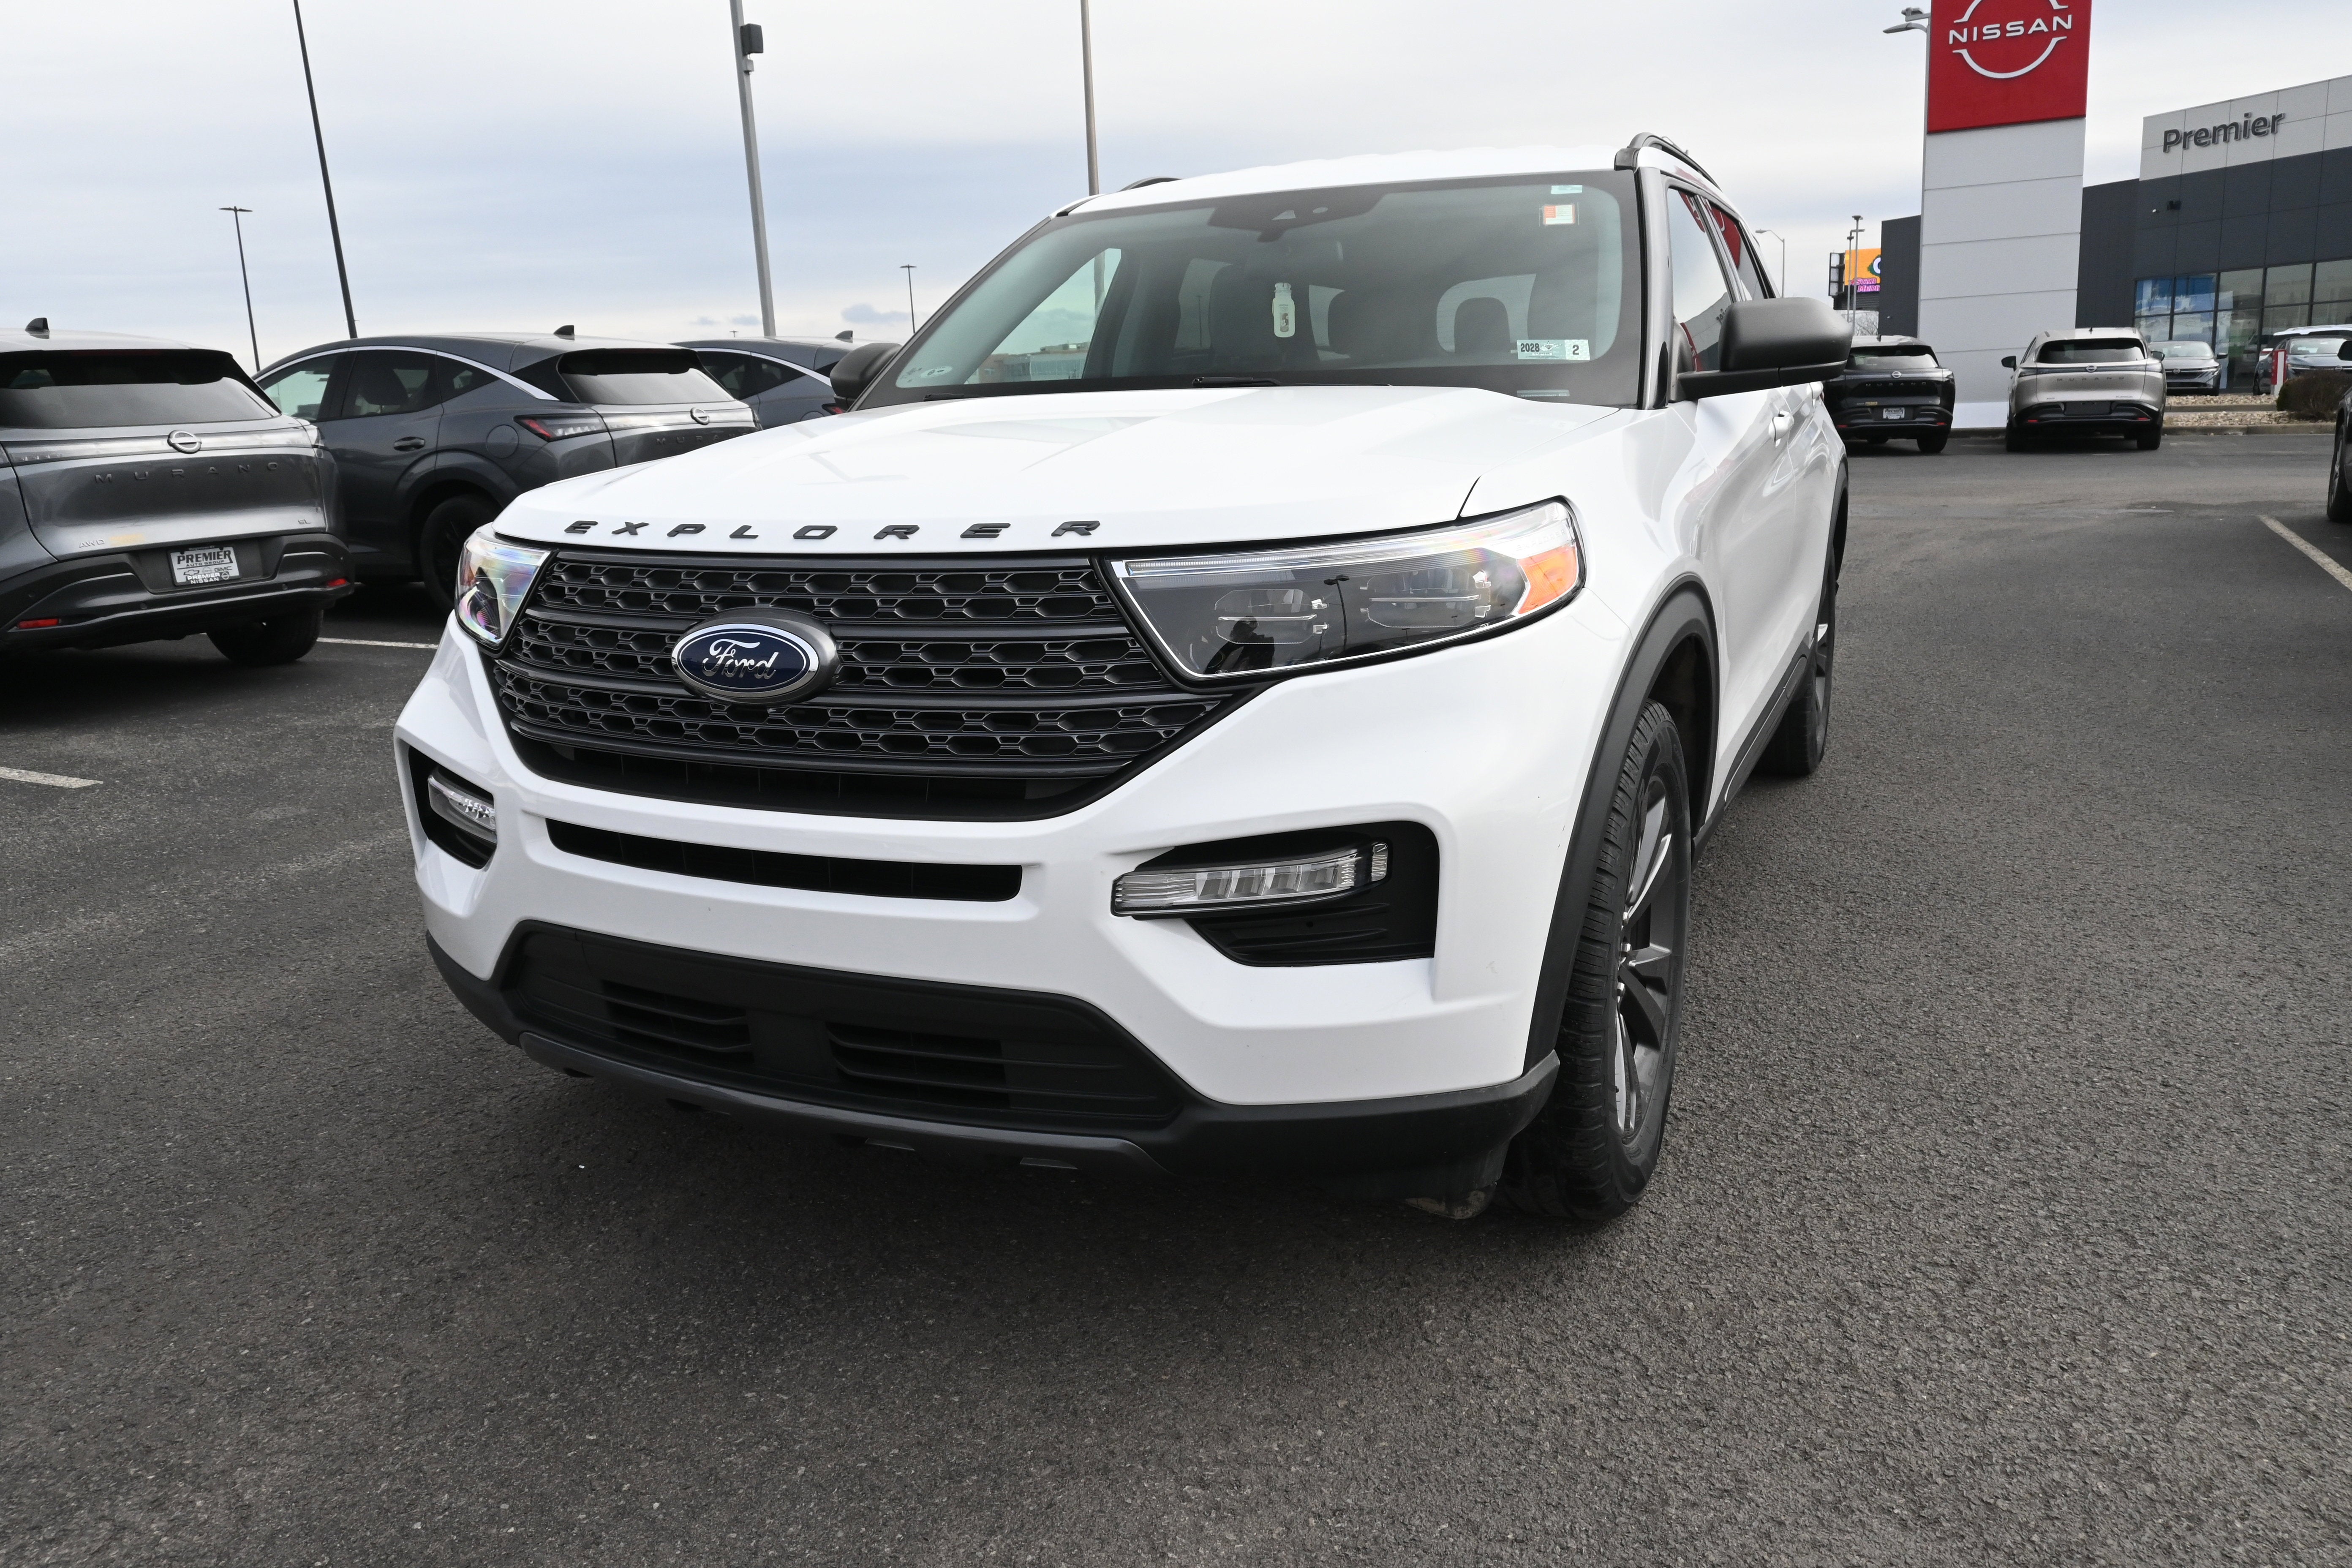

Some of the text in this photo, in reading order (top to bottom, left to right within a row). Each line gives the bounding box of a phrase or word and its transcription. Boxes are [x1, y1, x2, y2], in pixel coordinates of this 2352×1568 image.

[1949, 14, 2072, 45] NISSAN
[2163, 112, 2285, 153] Premier
[1520, 343, 1579, 355] 2028 2
[95, 462, 279, 483] MURANO
[564, 520, 1100, 540] EXPLORER
[79, 539, 105, 548] AWD
[177, 550, 233, 565] PREMIER
[187, 572, 220, 581] PREMIER
[702, 638, 779, 680] Ford
